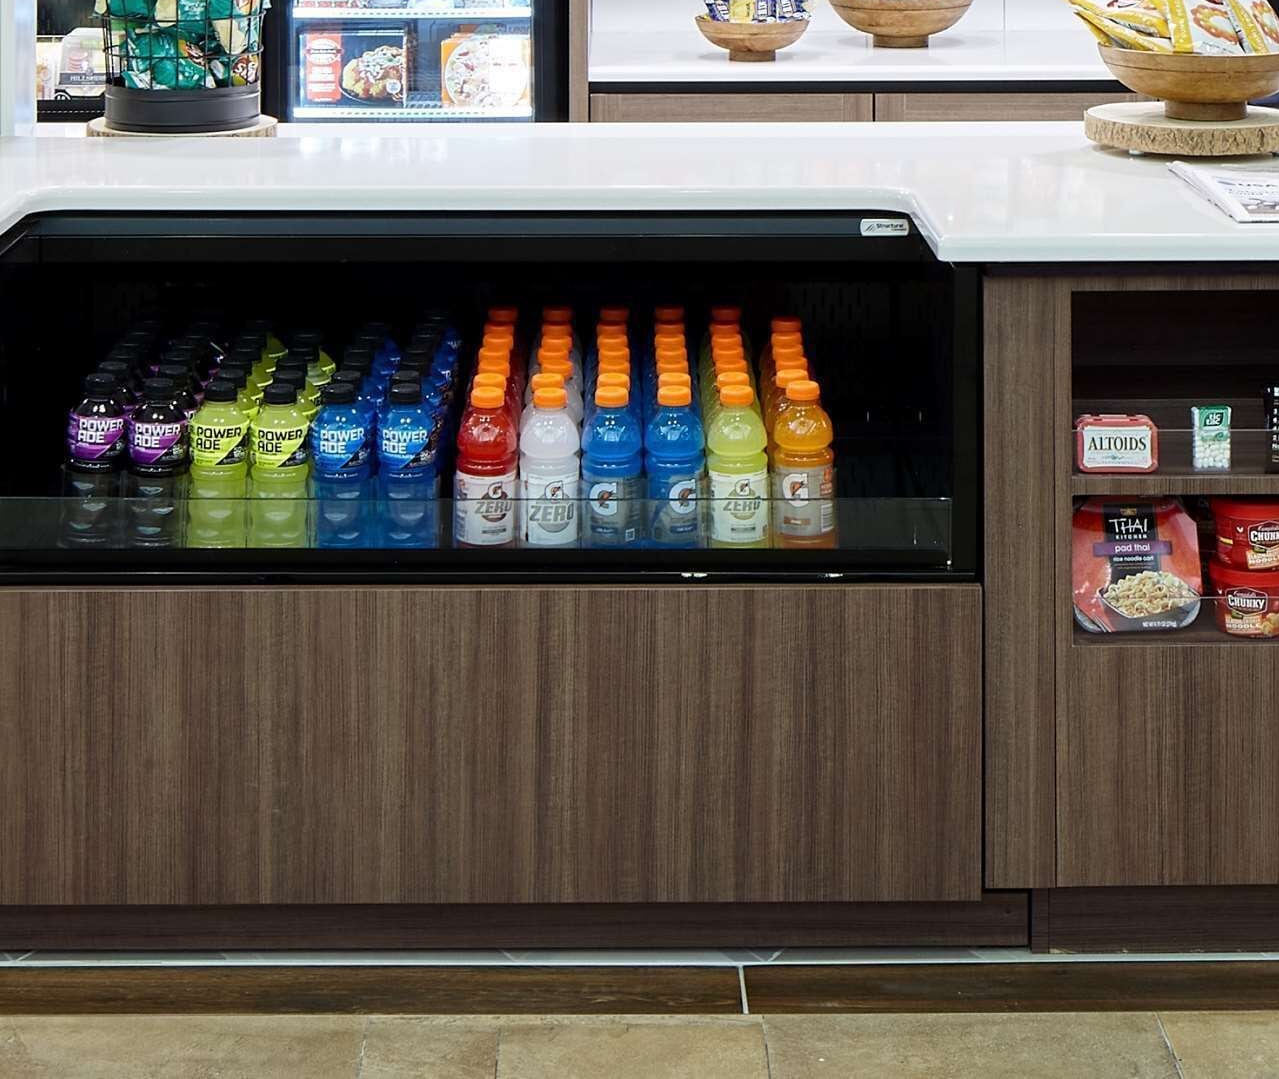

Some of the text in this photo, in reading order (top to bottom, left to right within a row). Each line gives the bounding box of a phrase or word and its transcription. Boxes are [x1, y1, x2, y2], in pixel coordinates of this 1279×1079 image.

[79, 418, 123, 432] POWER
[135, 423, 180, 436] POWER
[78, 430, 105, 443] ADE
[196, 426, 242, 439] POWER
[258, 429, 303, 441] POWER
[321, 428, 365, 442] POWER
[382, 428, 428, 443] POWER
[134, 435, 160, 448] ADE
[196, 438, 220, 451] ADE
[257, 440, 282, 453] ADE
[320, 441, 346, 454] ADE
[381, 441, 407, 454] ADE
[1088, 436, 1147, 451] ALTOIDS
[782, 473, 809, 507] G
[589, 482, 618, 516] G
[723, 497, 761, 512] ZERO
[475, 500, 512, 514] ZERO
[529, 503, 574, 521] ZERO
[1109, 518, 1149, 533] THAI
[1115, 543, 1151, 552] pad thai
[1228, 594, 1265, 609] CHUNKY
